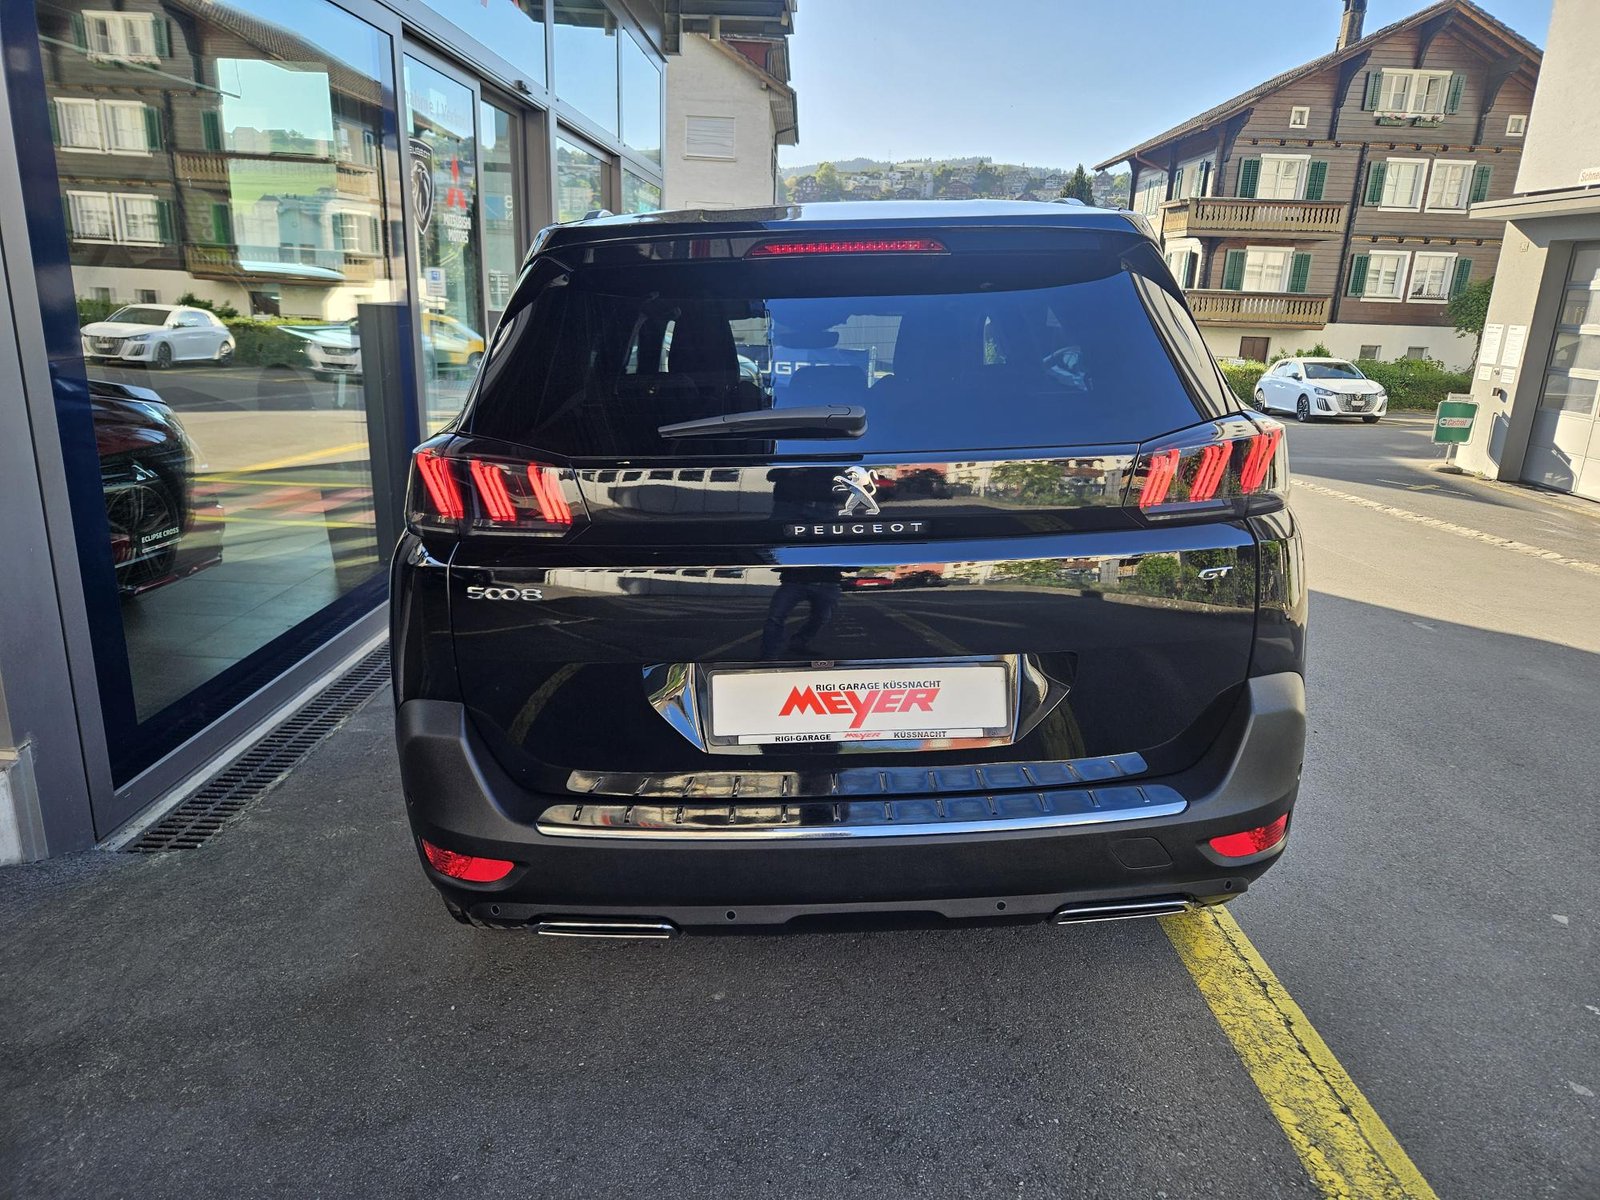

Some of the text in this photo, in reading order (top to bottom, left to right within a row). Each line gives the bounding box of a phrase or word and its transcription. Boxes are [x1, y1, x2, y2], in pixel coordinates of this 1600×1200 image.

[408, 145, 431, 160] EUGEOT
[141, 527, 179, 543] ECLIPSE CROSS
[794, 522, 922, 535] PEUGEOT
[1198, 566, 1233, 580] GT
[467, 586, 543, 601] 5008
[838, 682, 880, 690] GARAGE
[883, 680, 941, 690] KÜSSNACHT
[778, 685, 941, 729] MEYER
[775, 733, 831, 742] RIGI-GARAGE
